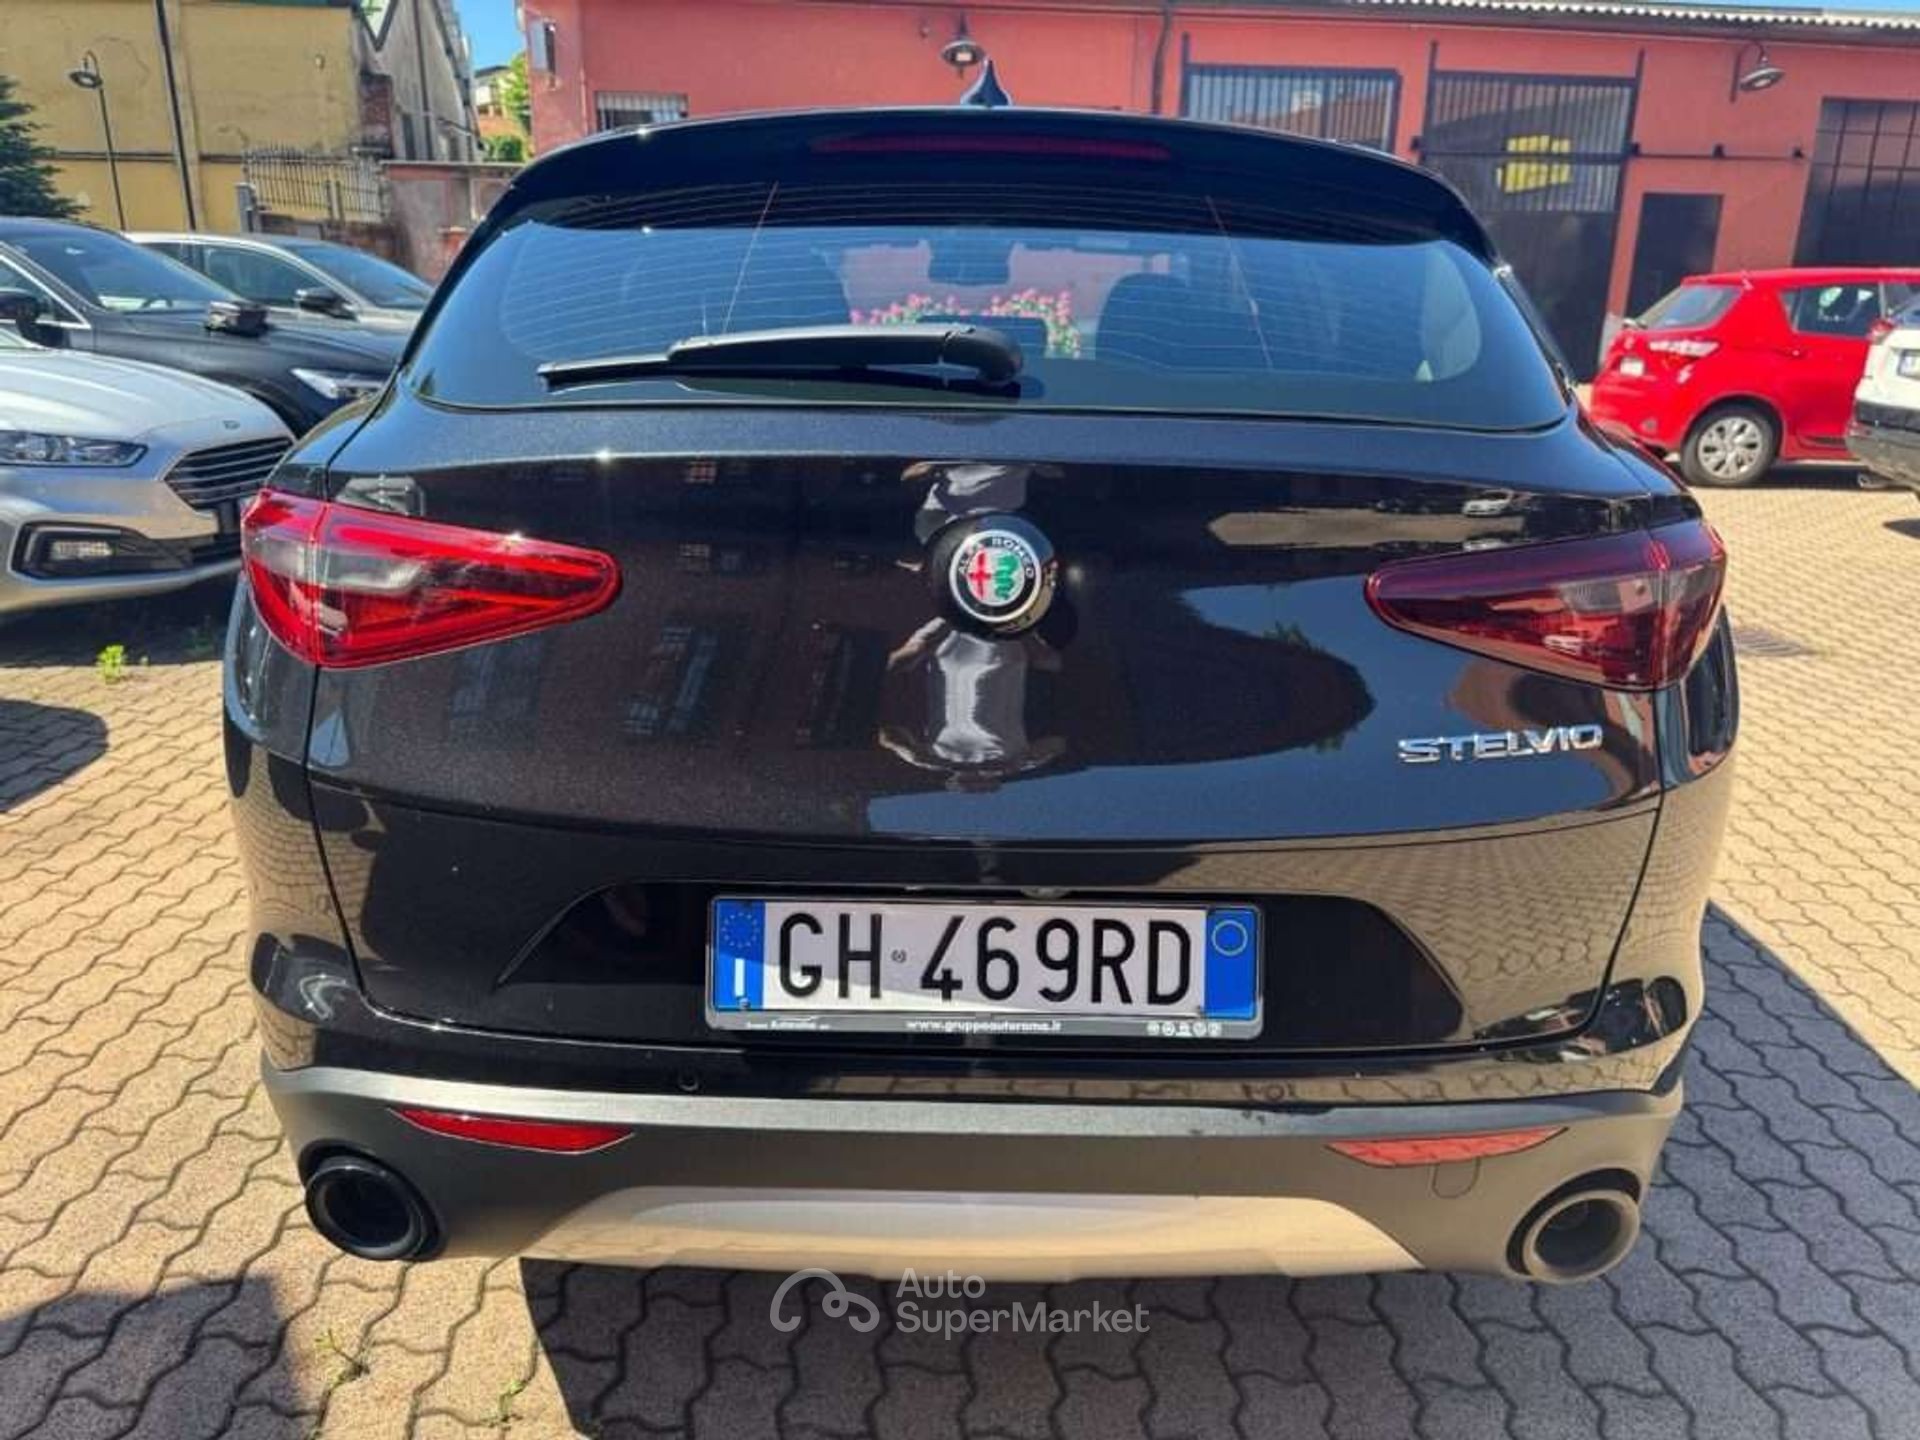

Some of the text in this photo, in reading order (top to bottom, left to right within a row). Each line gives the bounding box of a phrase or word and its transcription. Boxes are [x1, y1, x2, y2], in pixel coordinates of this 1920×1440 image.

[1398, 724, 1604, 763] STELVIO
[779, 912, 1192, 1006] GH 469RD
